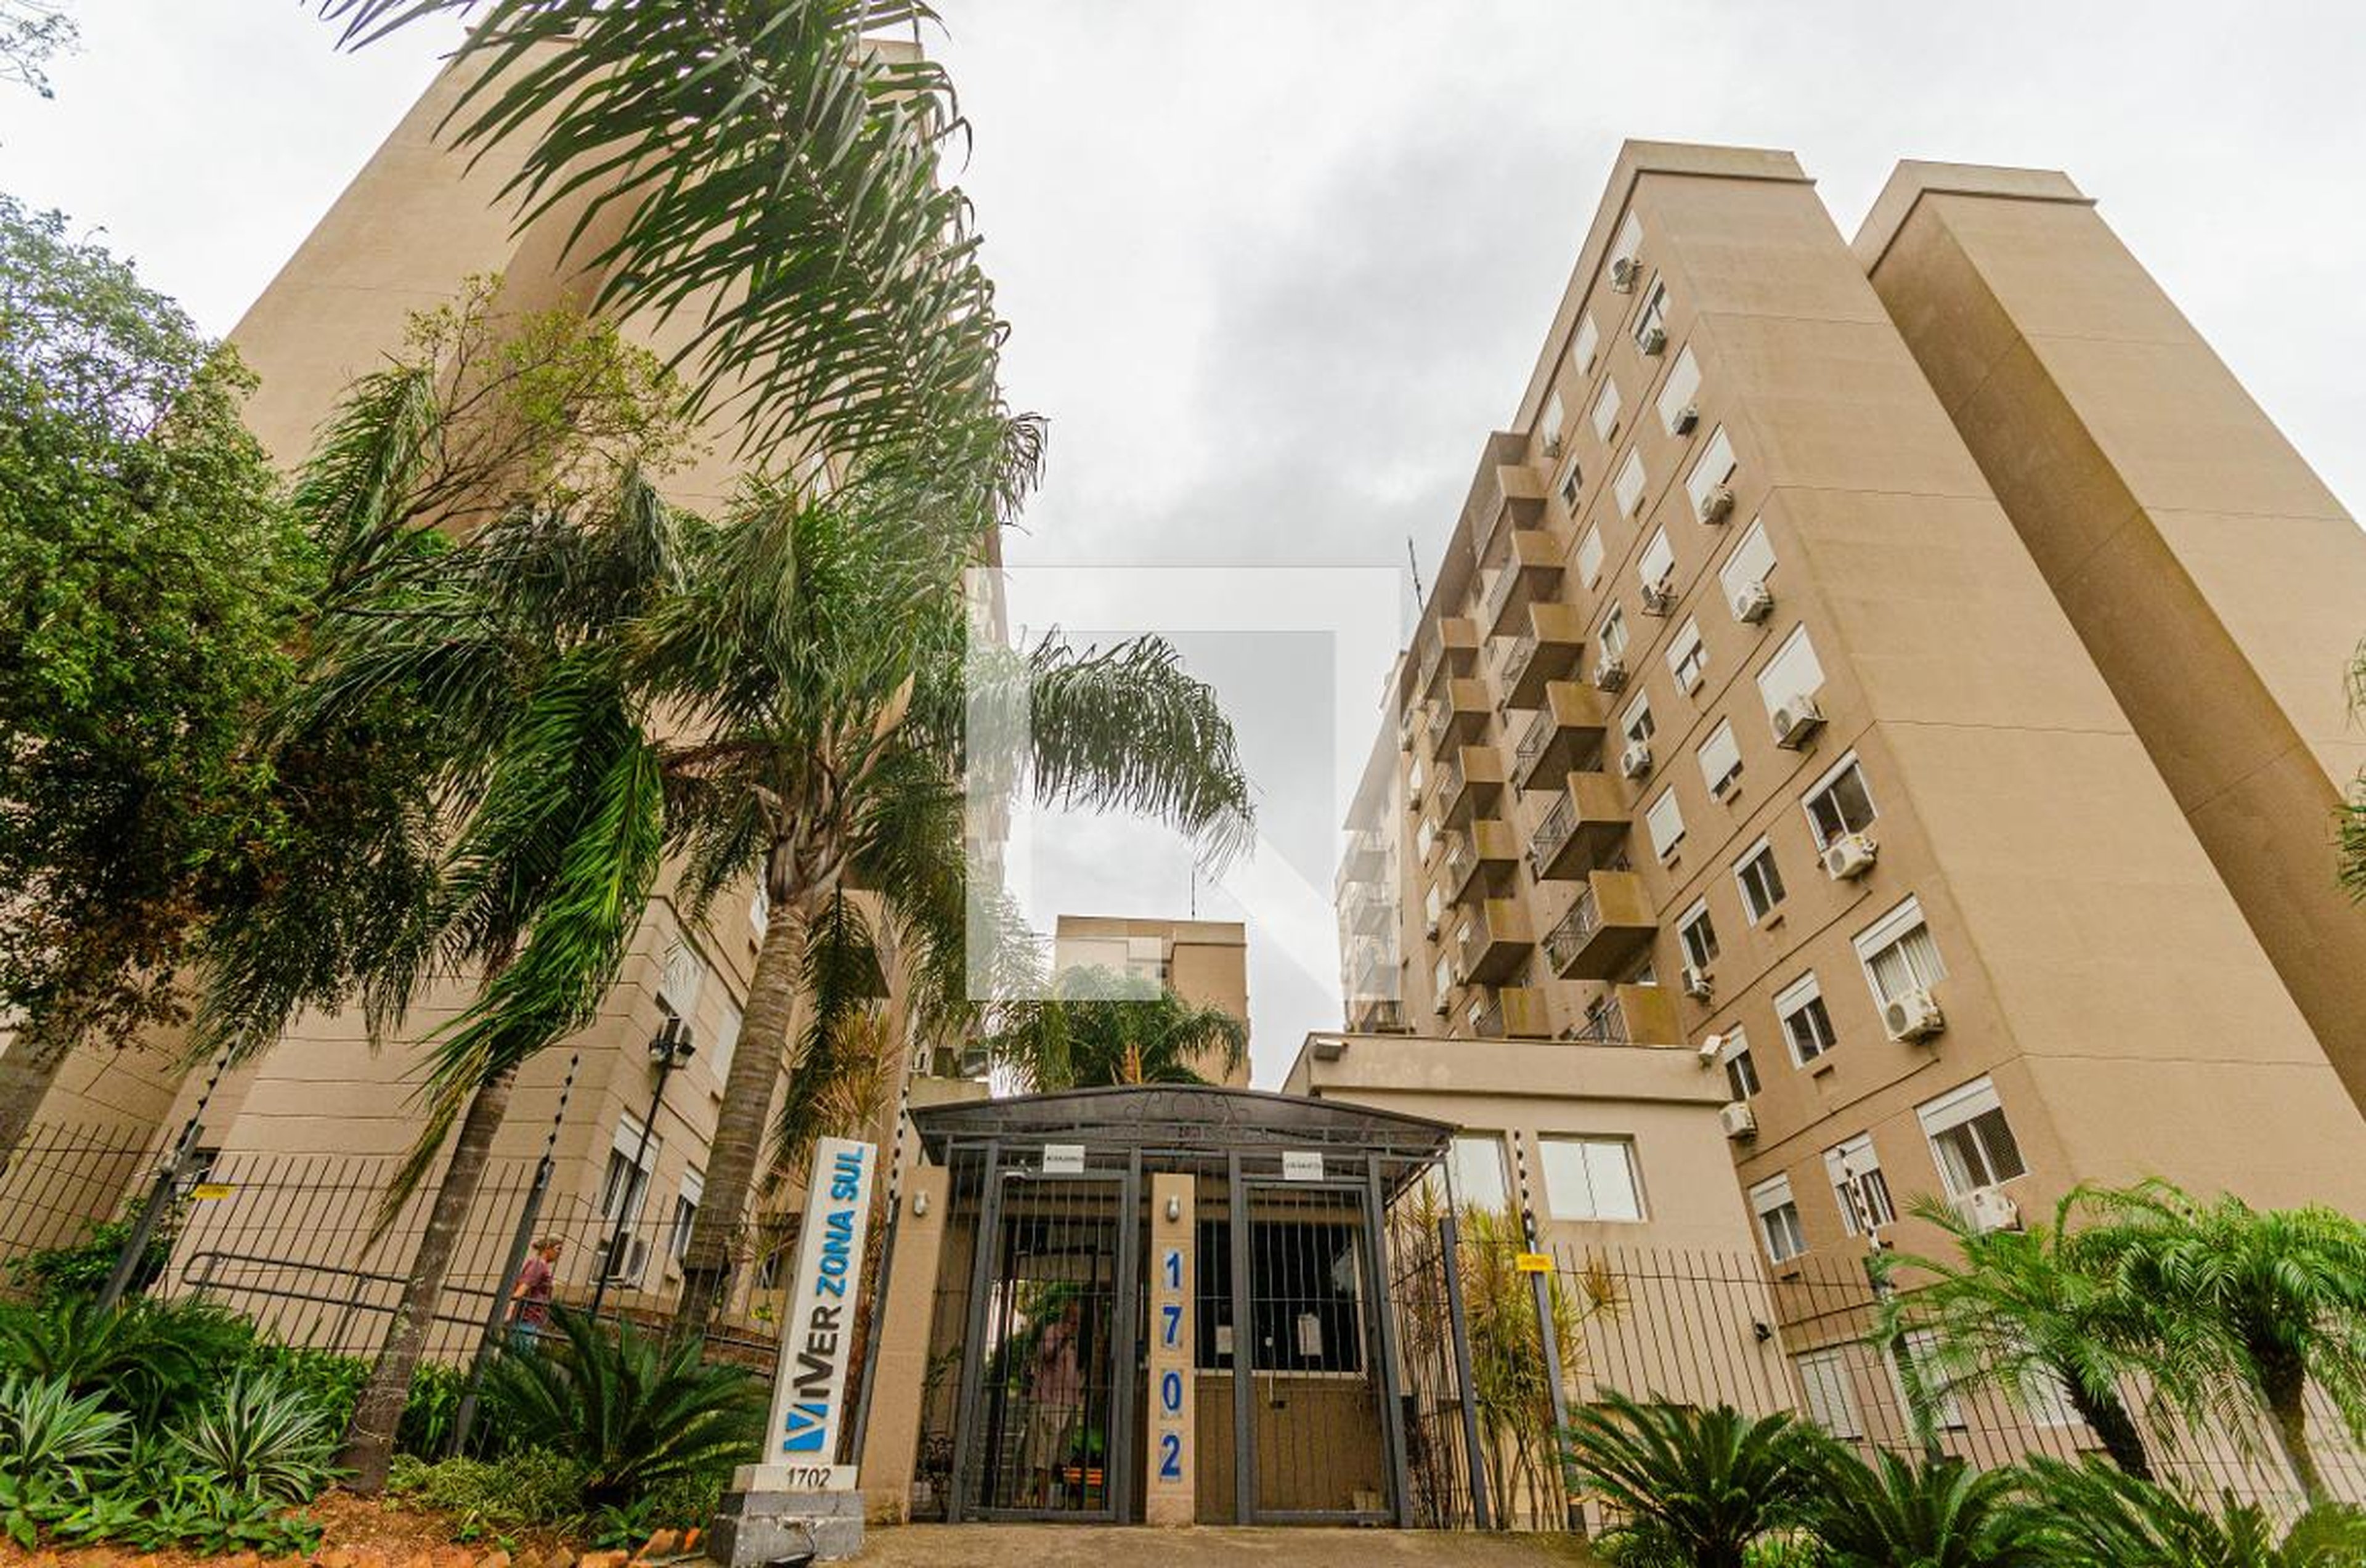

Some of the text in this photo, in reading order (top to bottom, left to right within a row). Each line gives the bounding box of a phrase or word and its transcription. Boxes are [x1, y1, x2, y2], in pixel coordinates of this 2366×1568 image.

[831, 1145, 865, 1201] SUL
[816, 1209, 855, 1298] ZONA
[1160, 1252, 1183, 1477] 1702
[787, 1467, 831, 1487] 1702
